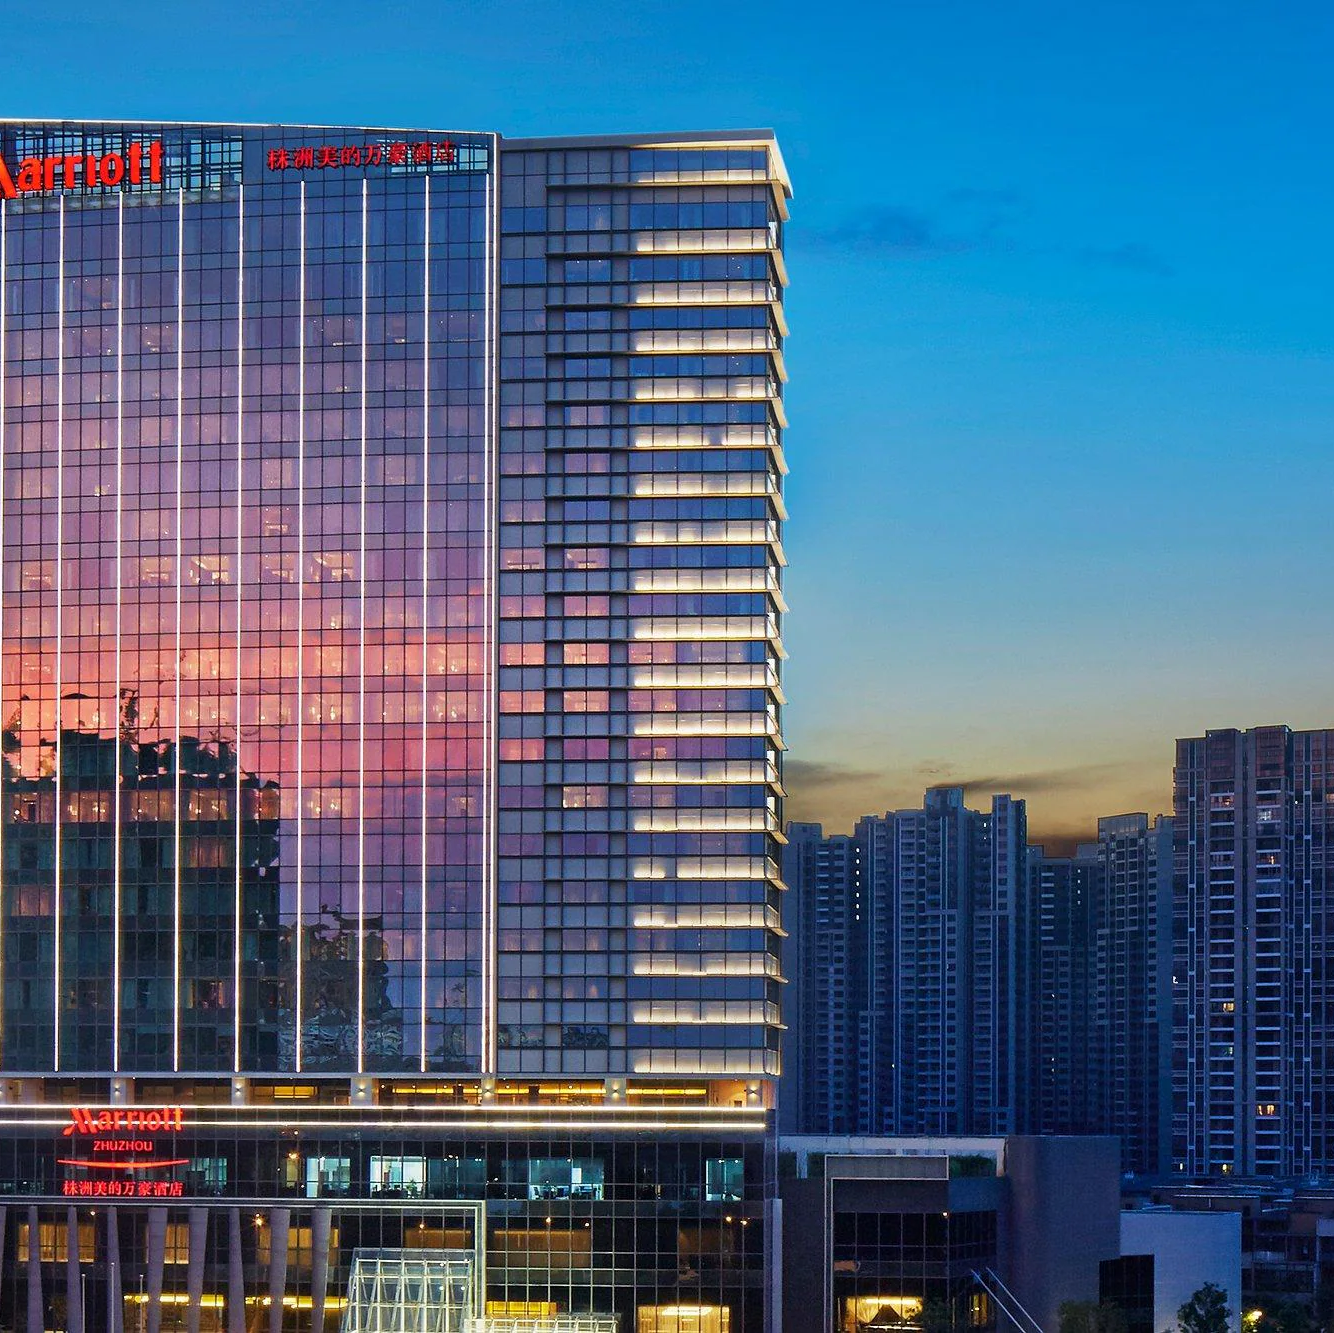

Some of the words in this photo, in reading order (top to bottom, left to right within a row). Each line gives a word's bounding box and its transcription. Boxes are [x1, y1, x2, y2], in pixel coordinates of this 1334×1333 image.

[267, 140, 456, 171] 株洲美的万豪酒店
[63, 1106, 184, 1136] Marriott
[93, 1140, 153, 1151] ZHUZHOU
[63, 1180, 184, 1197] 株洲美的万豪酒店
